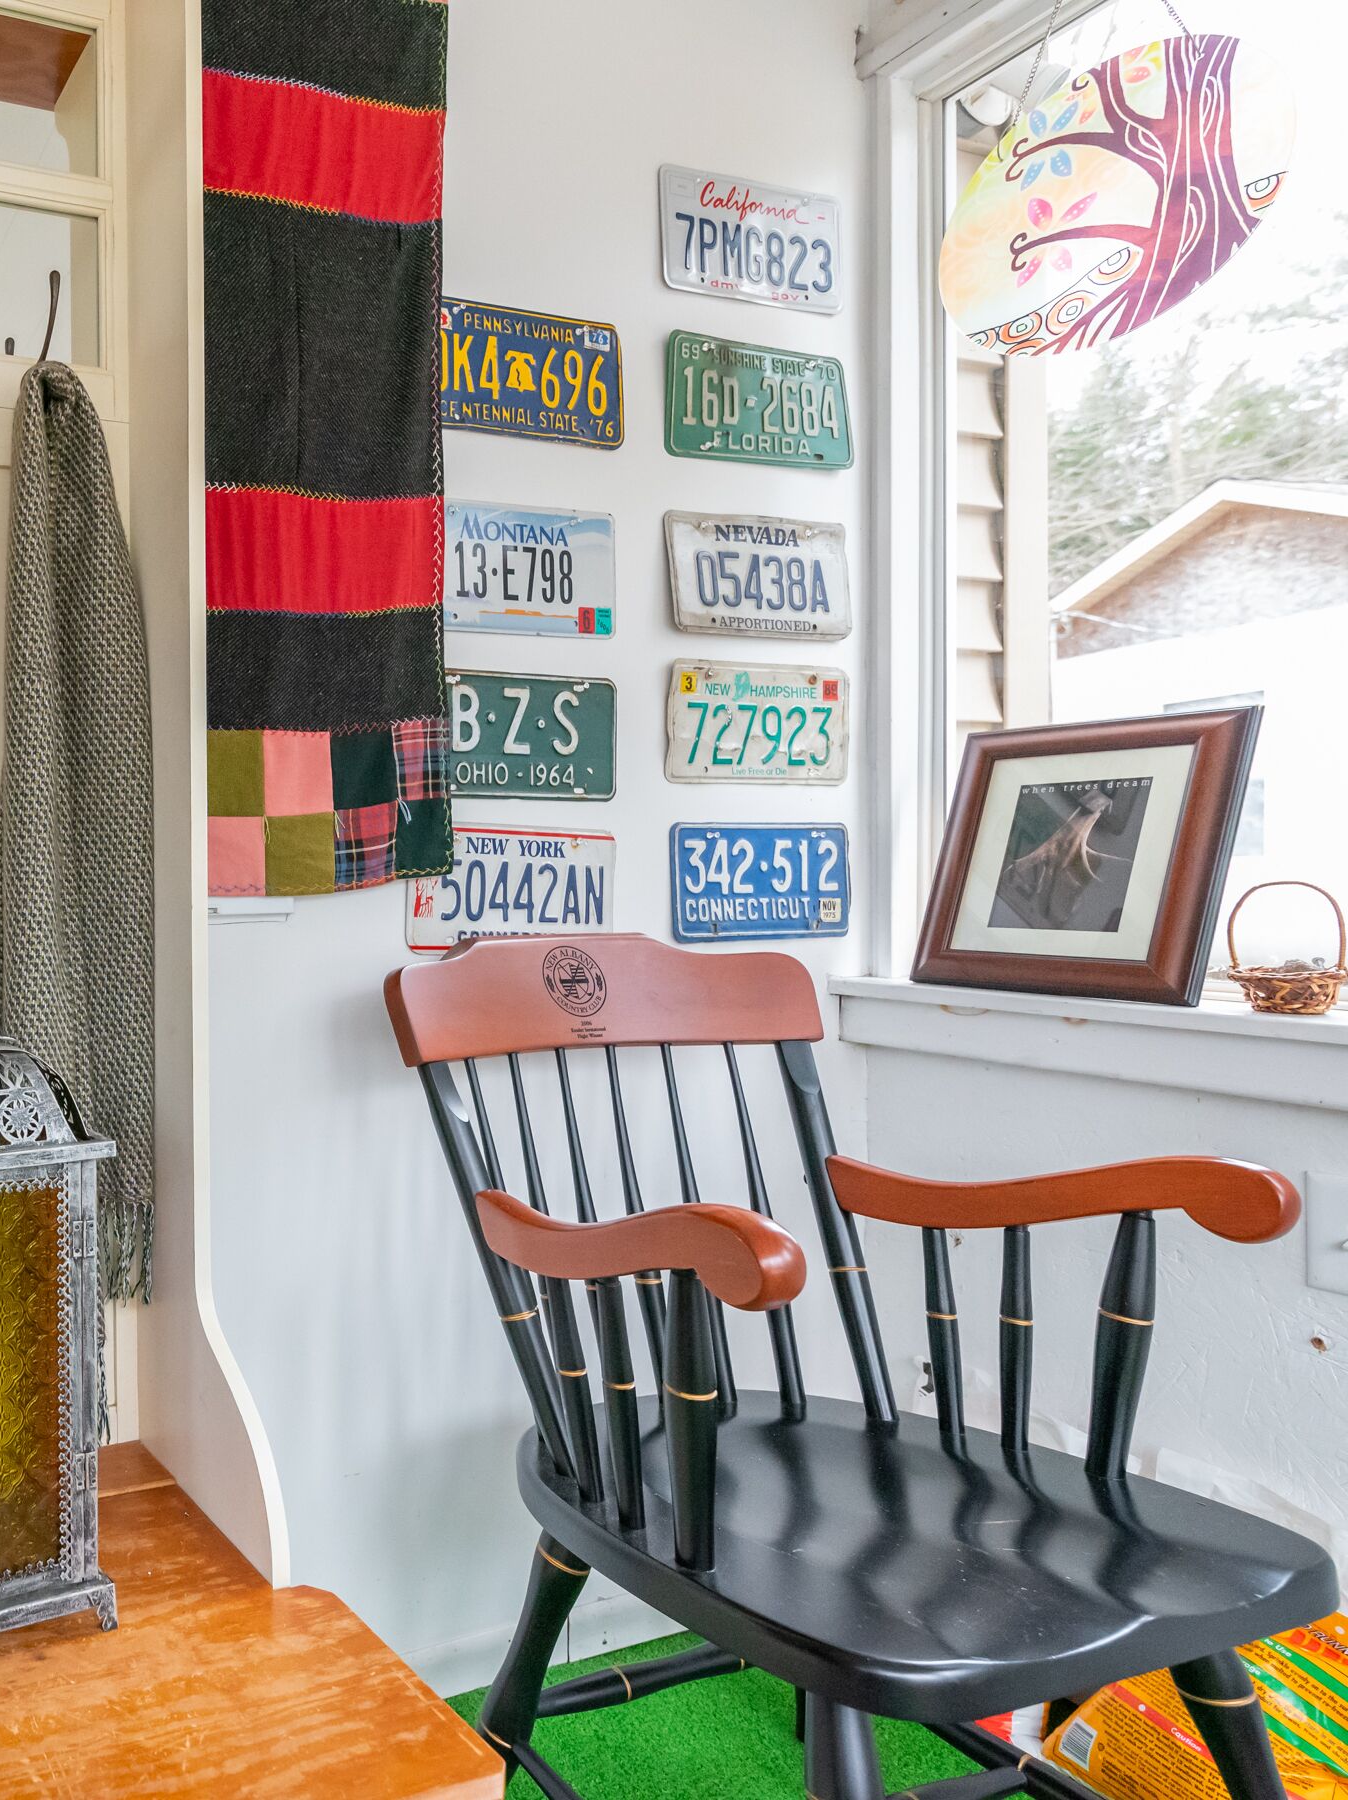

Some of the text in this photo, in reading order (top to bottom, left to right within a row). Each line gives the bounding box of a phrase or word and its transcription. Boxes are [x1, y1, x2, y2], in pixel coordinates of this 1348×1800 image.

[699, 181, 809, 225] California
[676, 212, 832, 293] 7PMG823
[464, 312, 575, 345] PENNSYLVANIA
[591, 332, 604, 344] 76
[682, 343, 836, 380] 69 SUNSHINE STATE 70
[540, 412, 578, 433] STATE
[713, 430, 811, 456] FLORIDA
[714, 524, 800, 547] NEVADA
[696, 551, 830, 613] 05438A
[719, 616, 811, 632] APPORTIONED
[685, 676, 693, 691] 3
[705, 682, 817, 699] NEW HAMPSHIRE
[687, 701, 833, 766] 727923
[748, 767, 764, 775] Free
[775, 767, 787, 775] Die
[1022, 779, 1151, 794] when trees dream
[466, 837, 566, 858] NEW YORK
[685, 898, 810, 922] CONNECTICUT
[822, 900, 836, 911] NOV
[545, 949, 596, 972] NEW ALBANY
[557, 995, 602, 1014] COUNTRY CLUB
[1275, 1643, 1293, 1658] Use
[1170, 1727, 1202, 1752] Caution
